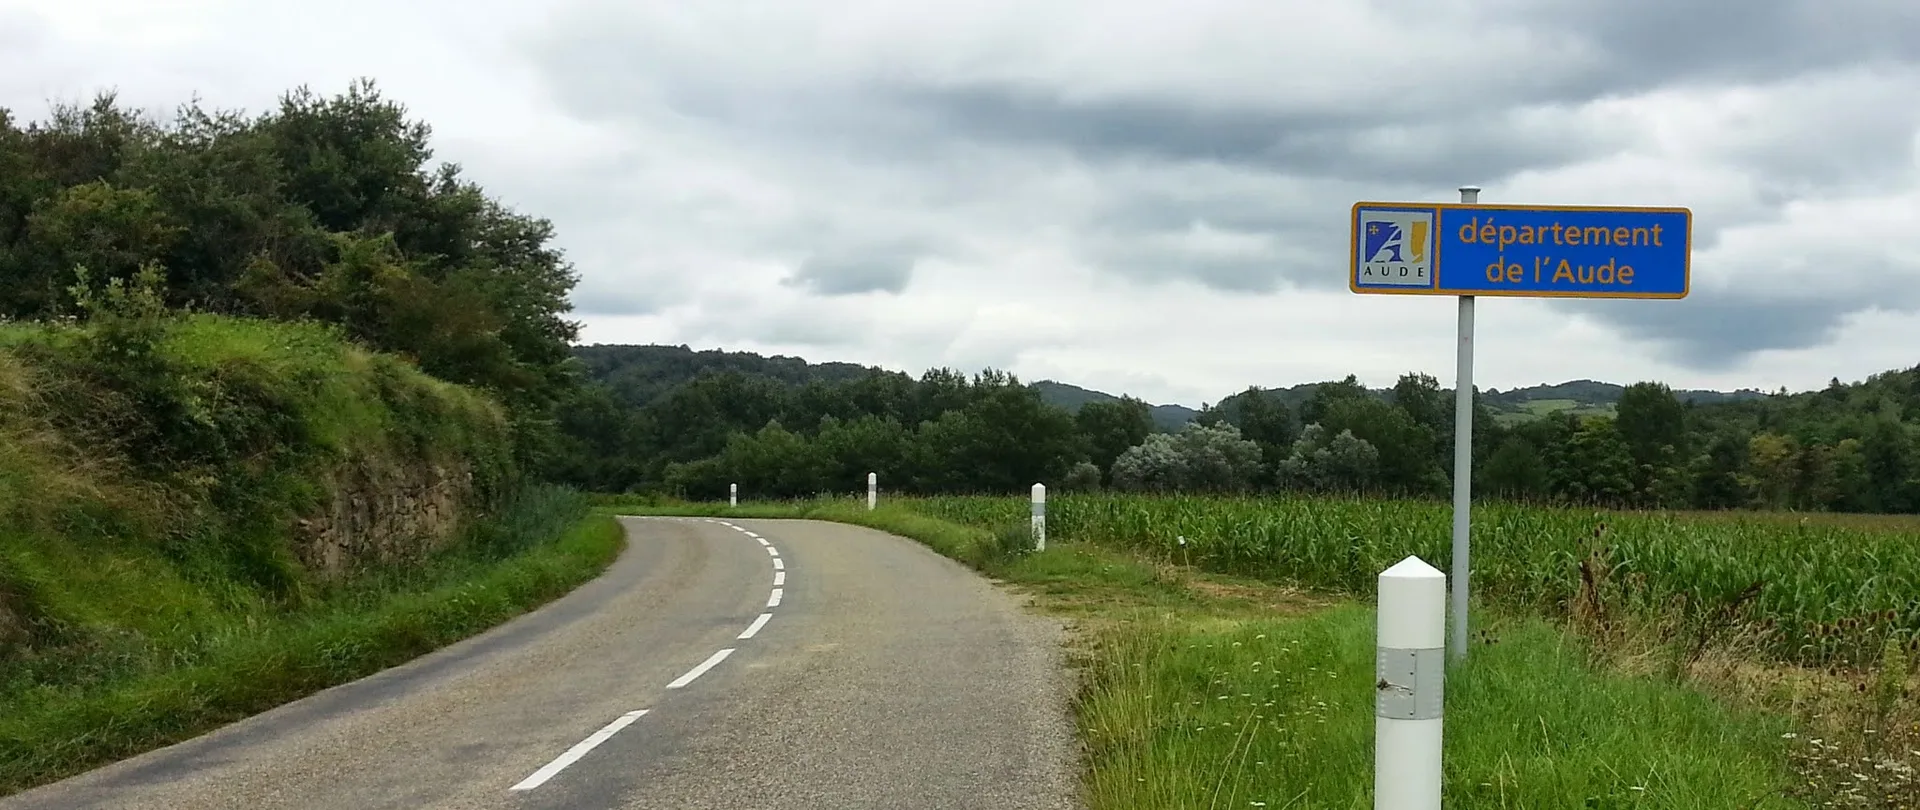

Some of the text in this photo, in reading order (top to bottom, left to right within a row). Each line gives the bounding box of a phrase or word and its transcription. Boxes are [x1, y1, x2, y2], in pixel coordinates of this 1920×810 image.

[1459, 217, 1663, 251] département
[1364, 265, 1424, 278] AUDE
[1486, 256, 1635, 285] de l'Aude
